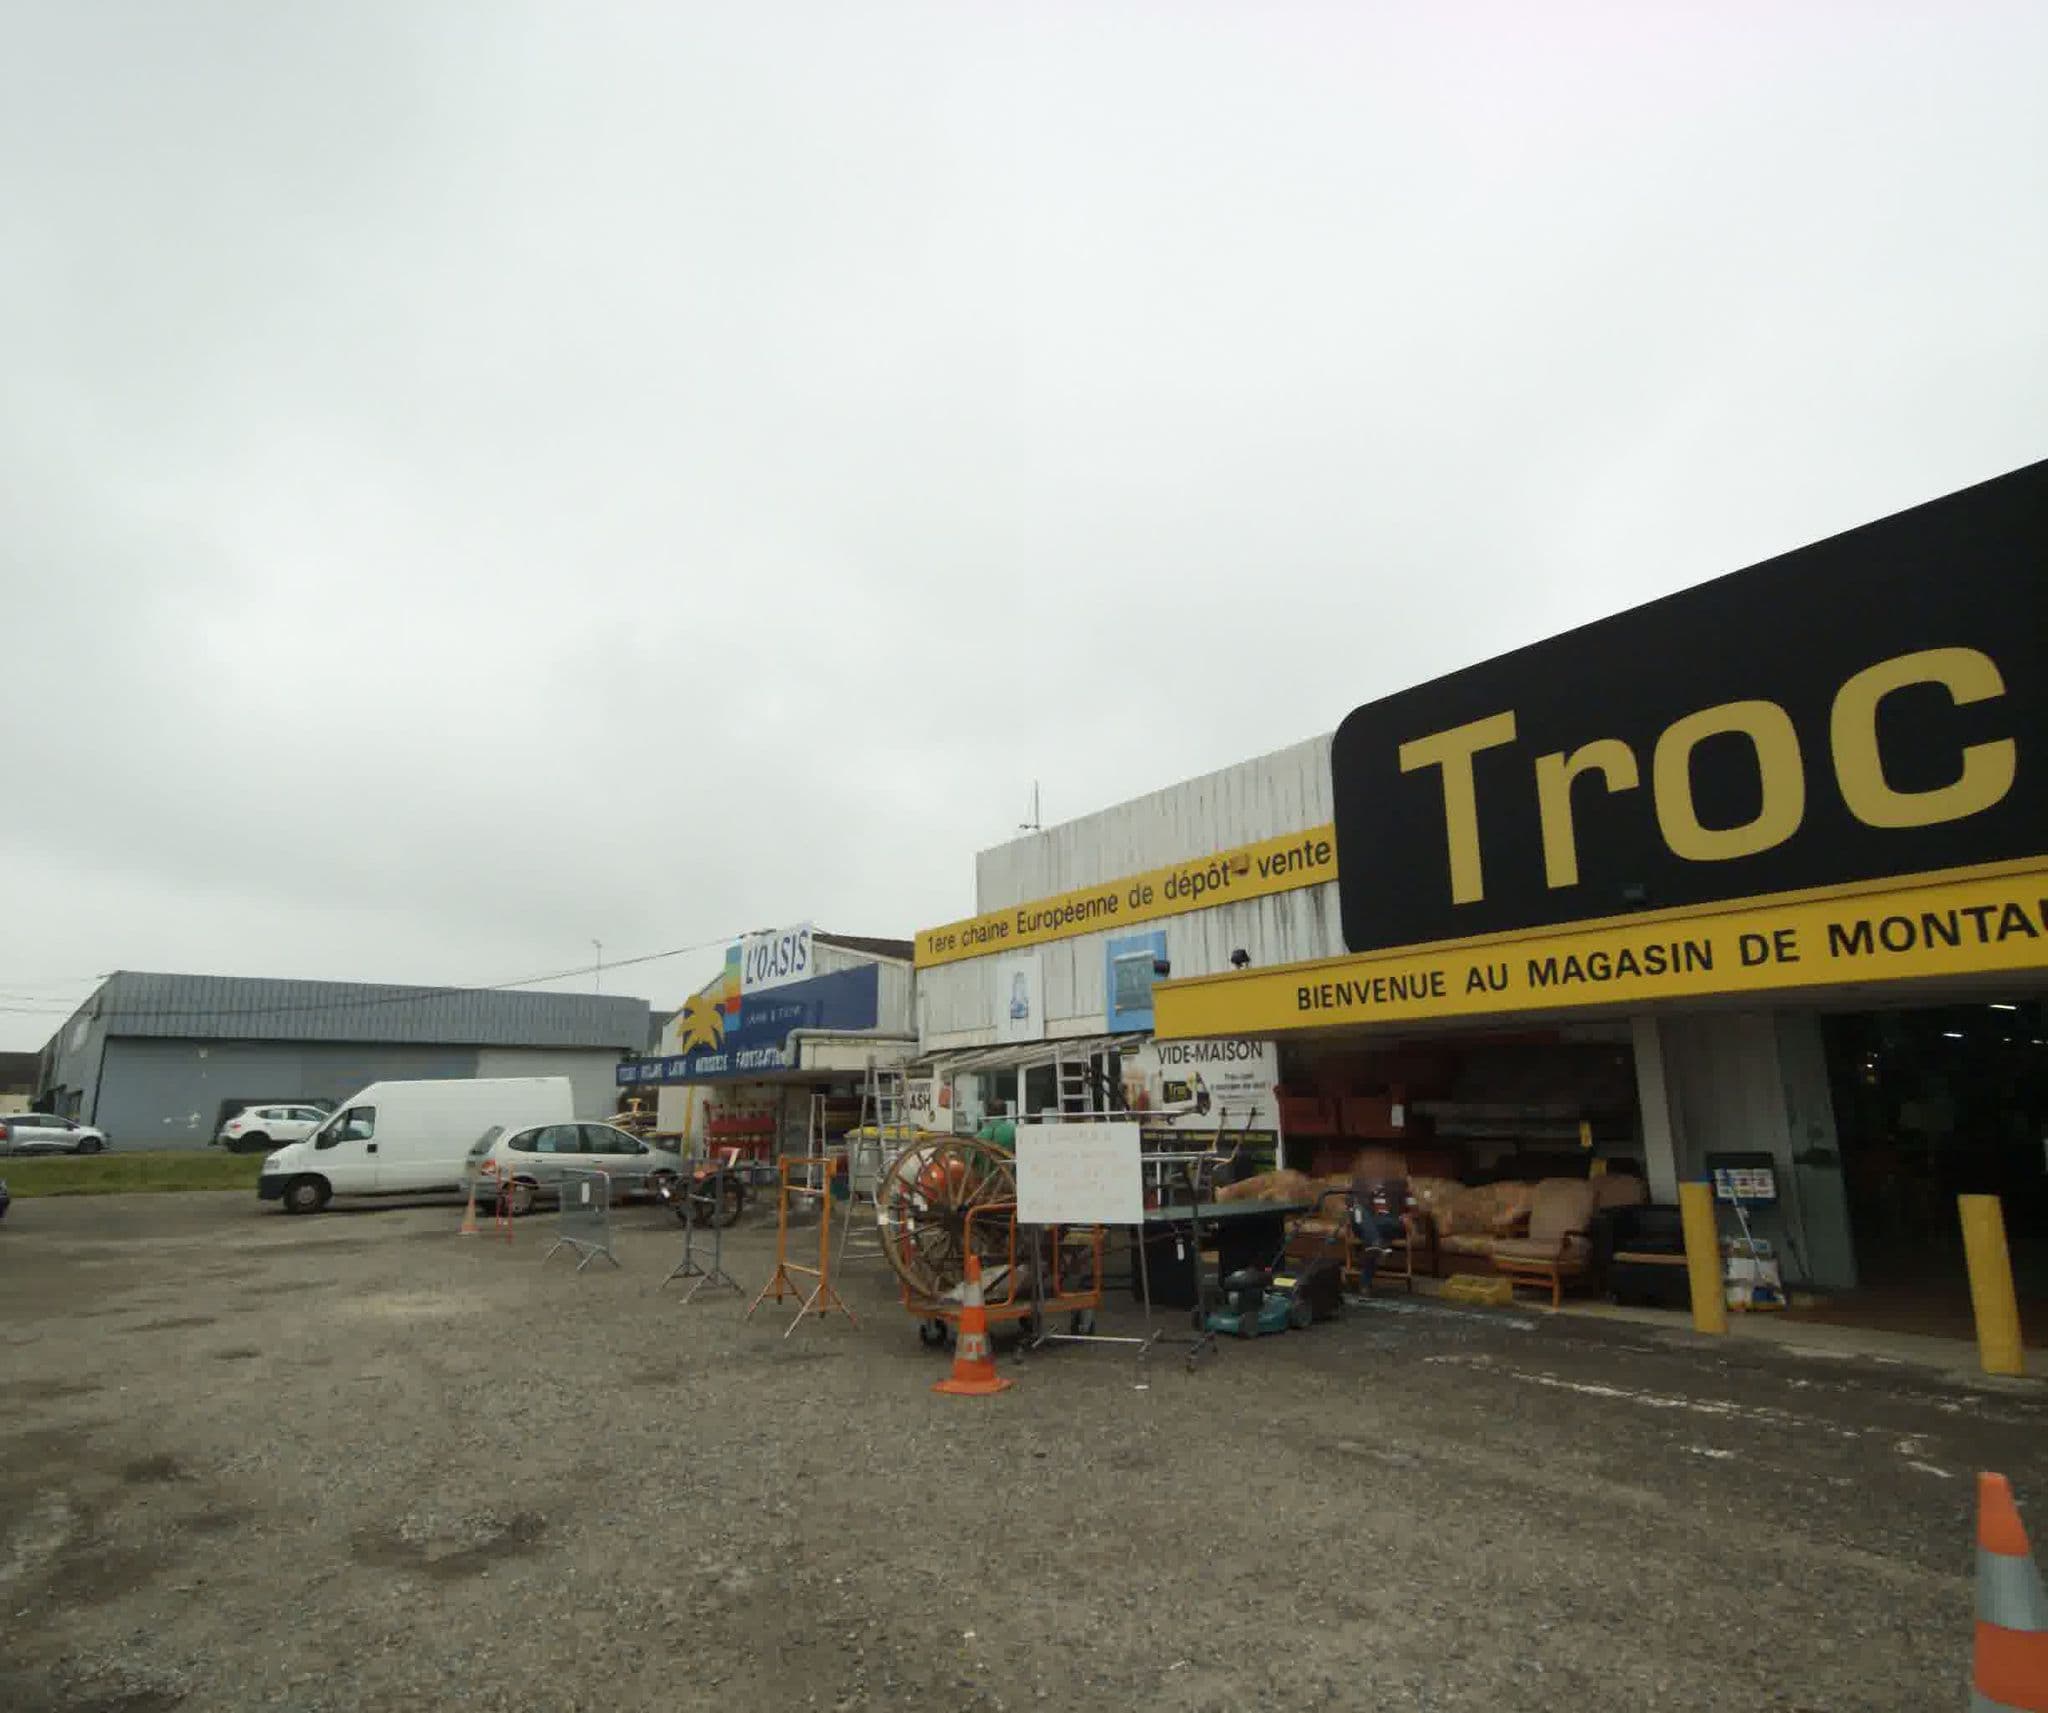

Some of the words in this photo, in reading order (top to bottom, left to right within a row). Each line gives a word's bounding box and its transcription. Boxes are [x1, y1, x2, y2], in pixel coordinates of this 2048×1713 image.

[1398, 646, 2016, 906] Troc
[1016, 893, 1119, 934] Européenne
[1128, 883, 1154, 909] de
[1164, 861, 1230, 900] dépôt
[1257, 840, 1331, 879] vente
[746, 930, 806, 984] L'OASIS
[1297, 971, 1446, 1011] BIENVENUE
[1465, 963, 1509, 995] AU
[1526, 939, 1714, 988] MAGASIN
[1739, 928, 1800, 967] DE
[1157, 1040, 1263, 1065] VIDE-MAISON
